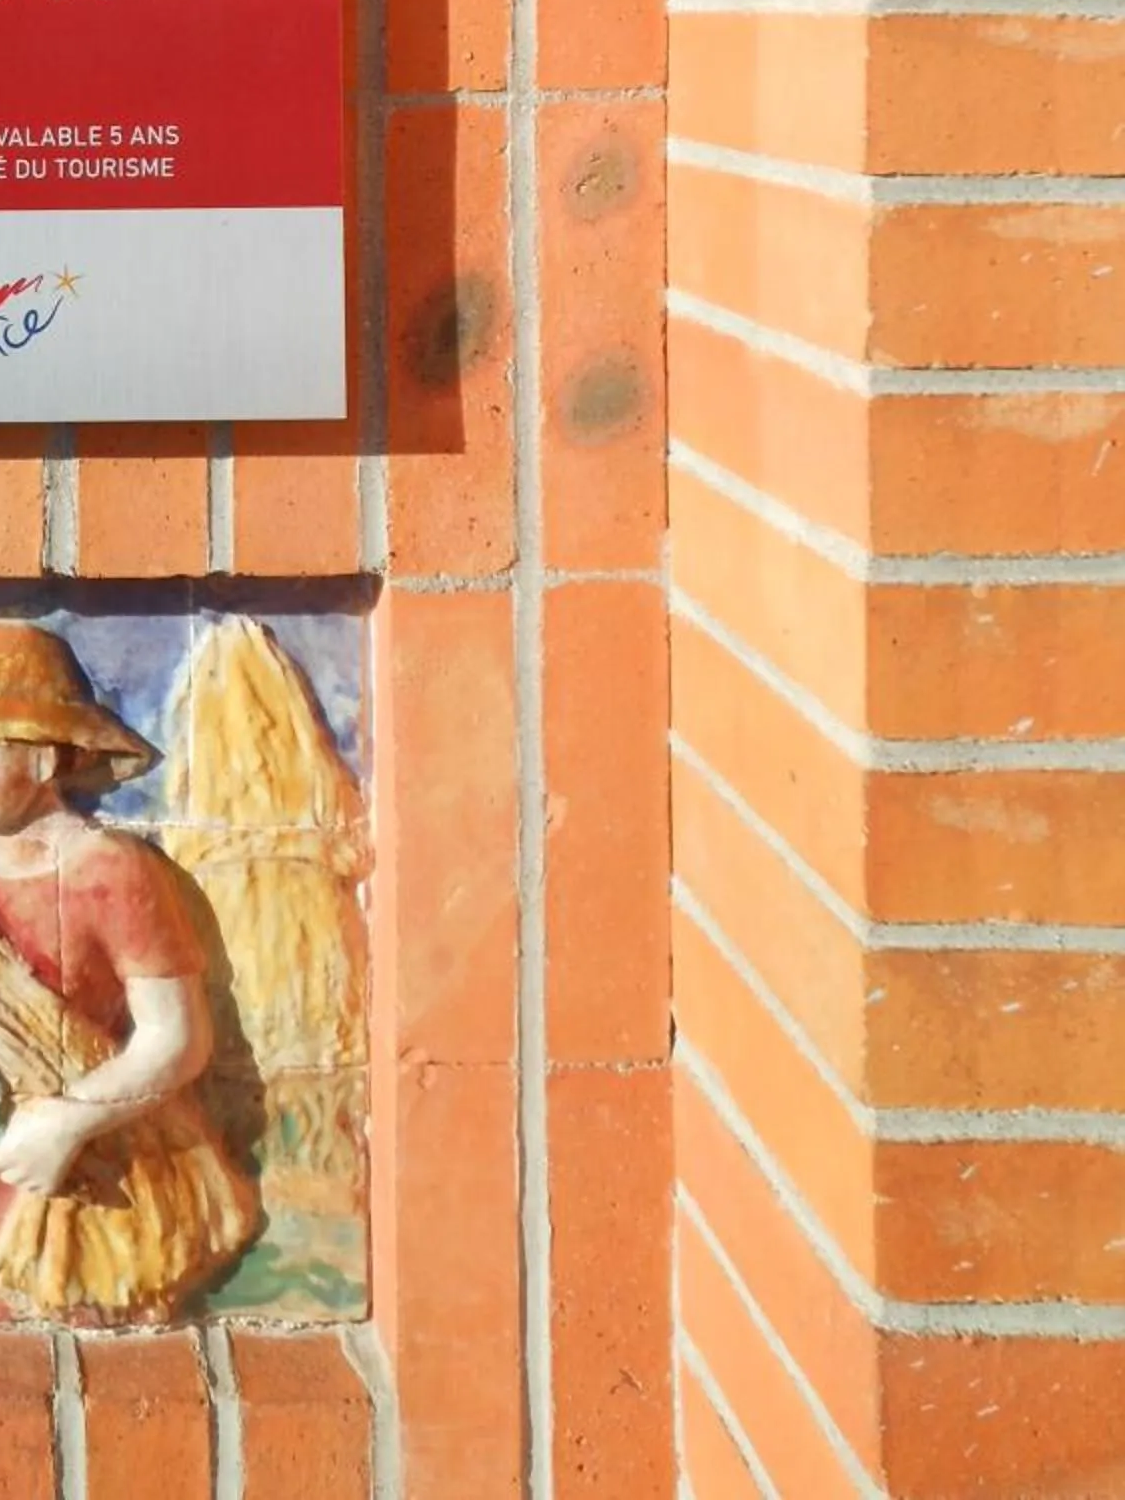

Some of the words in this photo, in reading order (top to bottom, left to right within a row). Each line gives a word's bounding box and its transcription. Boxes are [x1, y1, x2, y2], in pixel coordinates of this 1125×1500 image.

[110, 126, 122, 146] 5
[130, 125, 180, 145] ANS
[15, 159, 47, 179] DU
[55, 157, 174, 179] TOURISME
